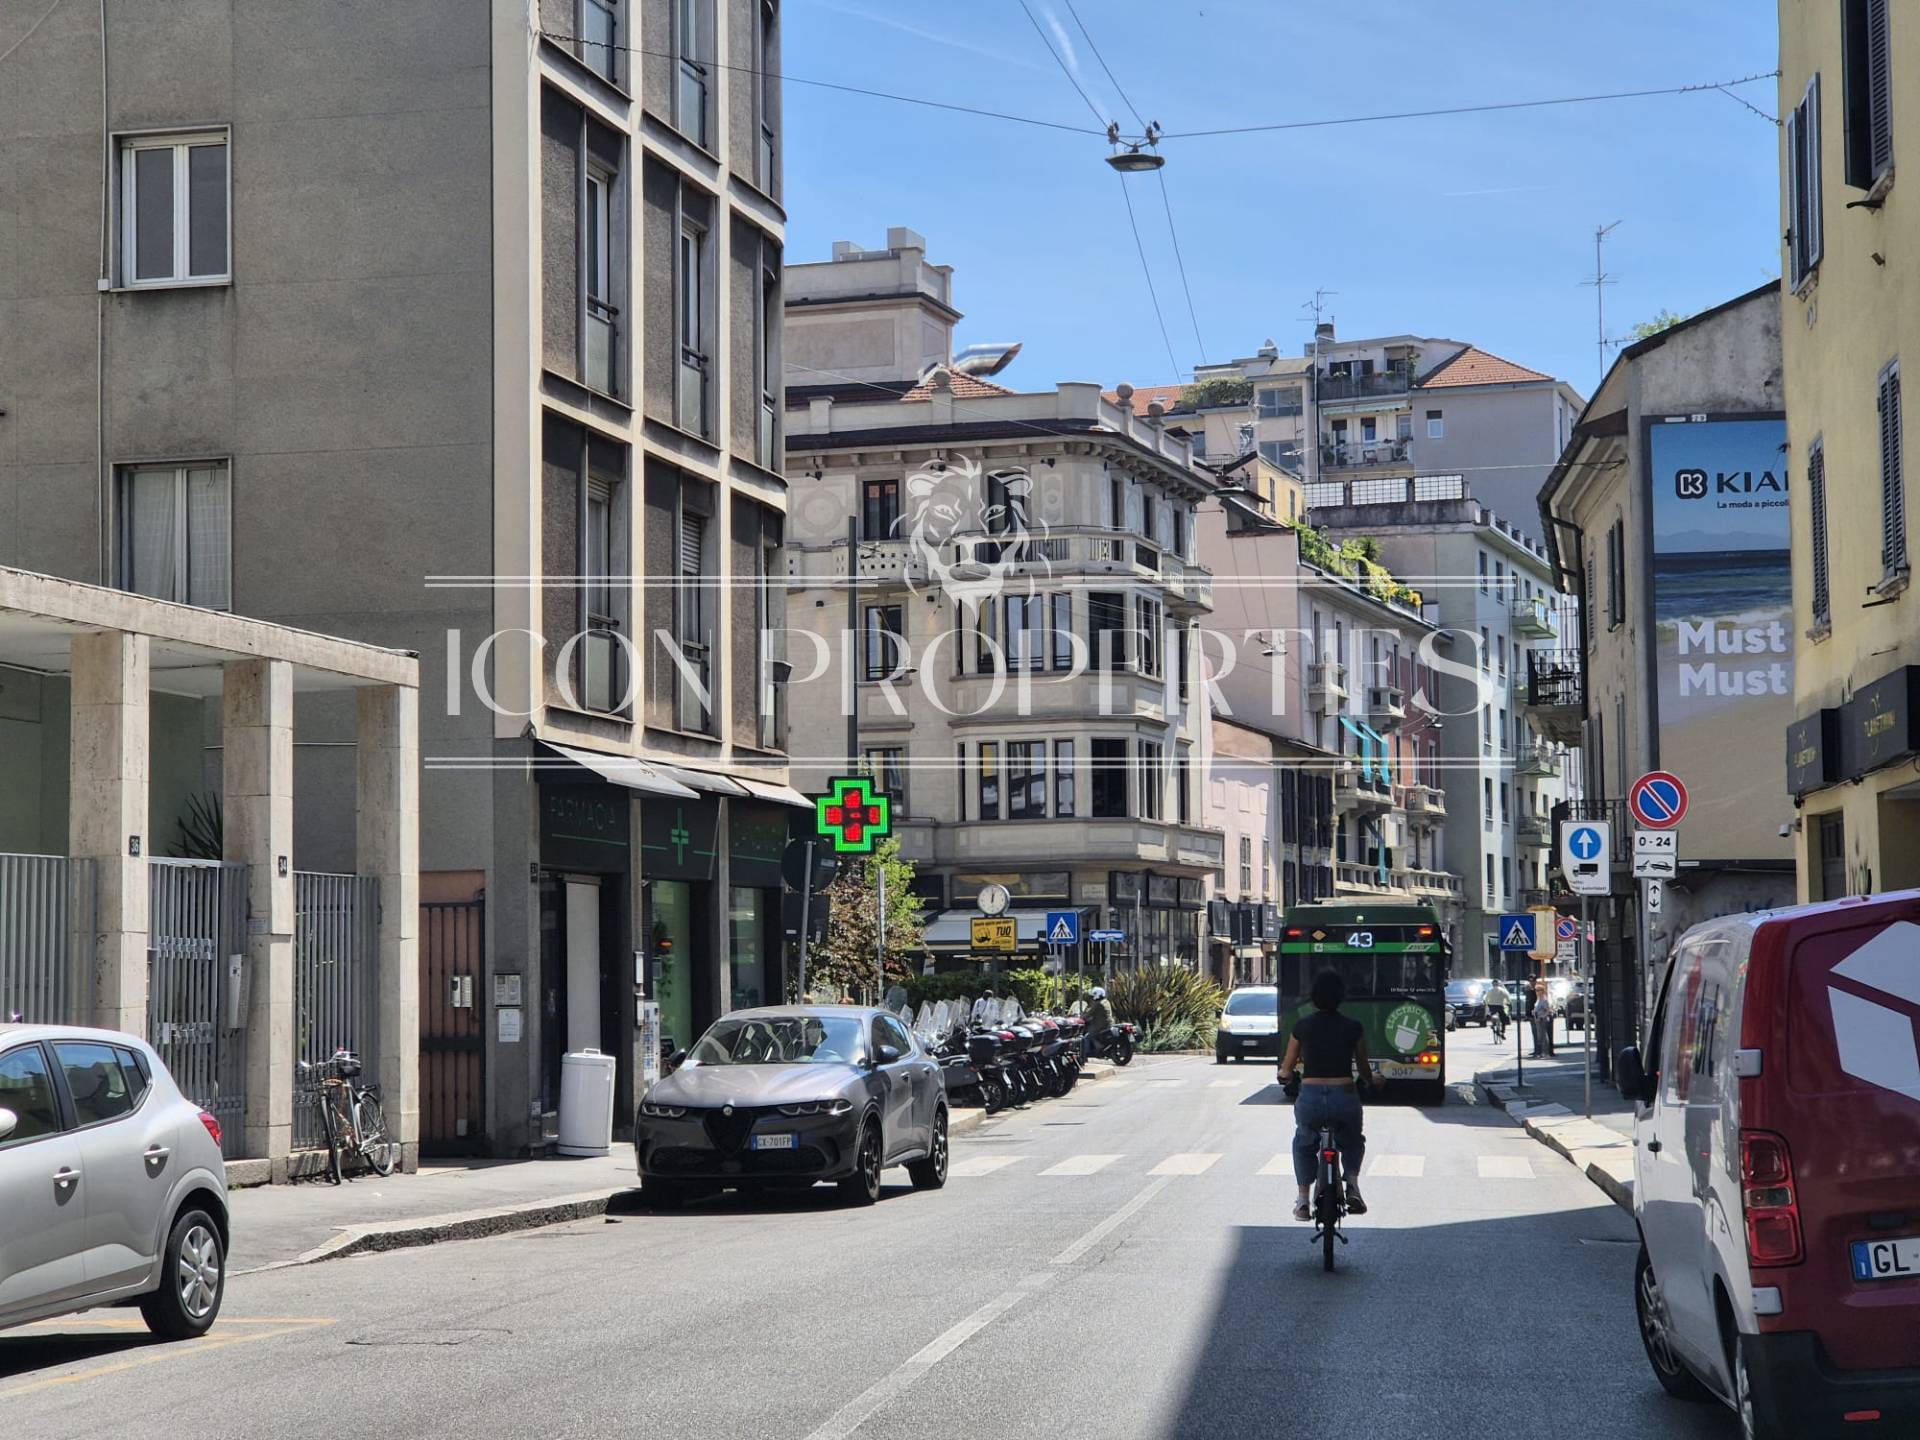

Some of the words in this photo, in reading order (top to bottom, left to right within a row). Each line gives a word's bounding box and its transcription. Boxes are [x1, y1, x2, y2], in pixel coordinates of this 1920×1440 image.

[1717, 471, 1789, 493] KIA
[1679, 621, 1786, 654] Must
[1679, 663, 1788, 696] Must
[1639, 836, 1647, 847] 0
[1656, 836, 1671, 847] 24
[1347, 932, 1373, 948] 43
[1386, 1005, 1421, 1030] ELECTRIC
[1873, 1243, 1910, 1273] GL
